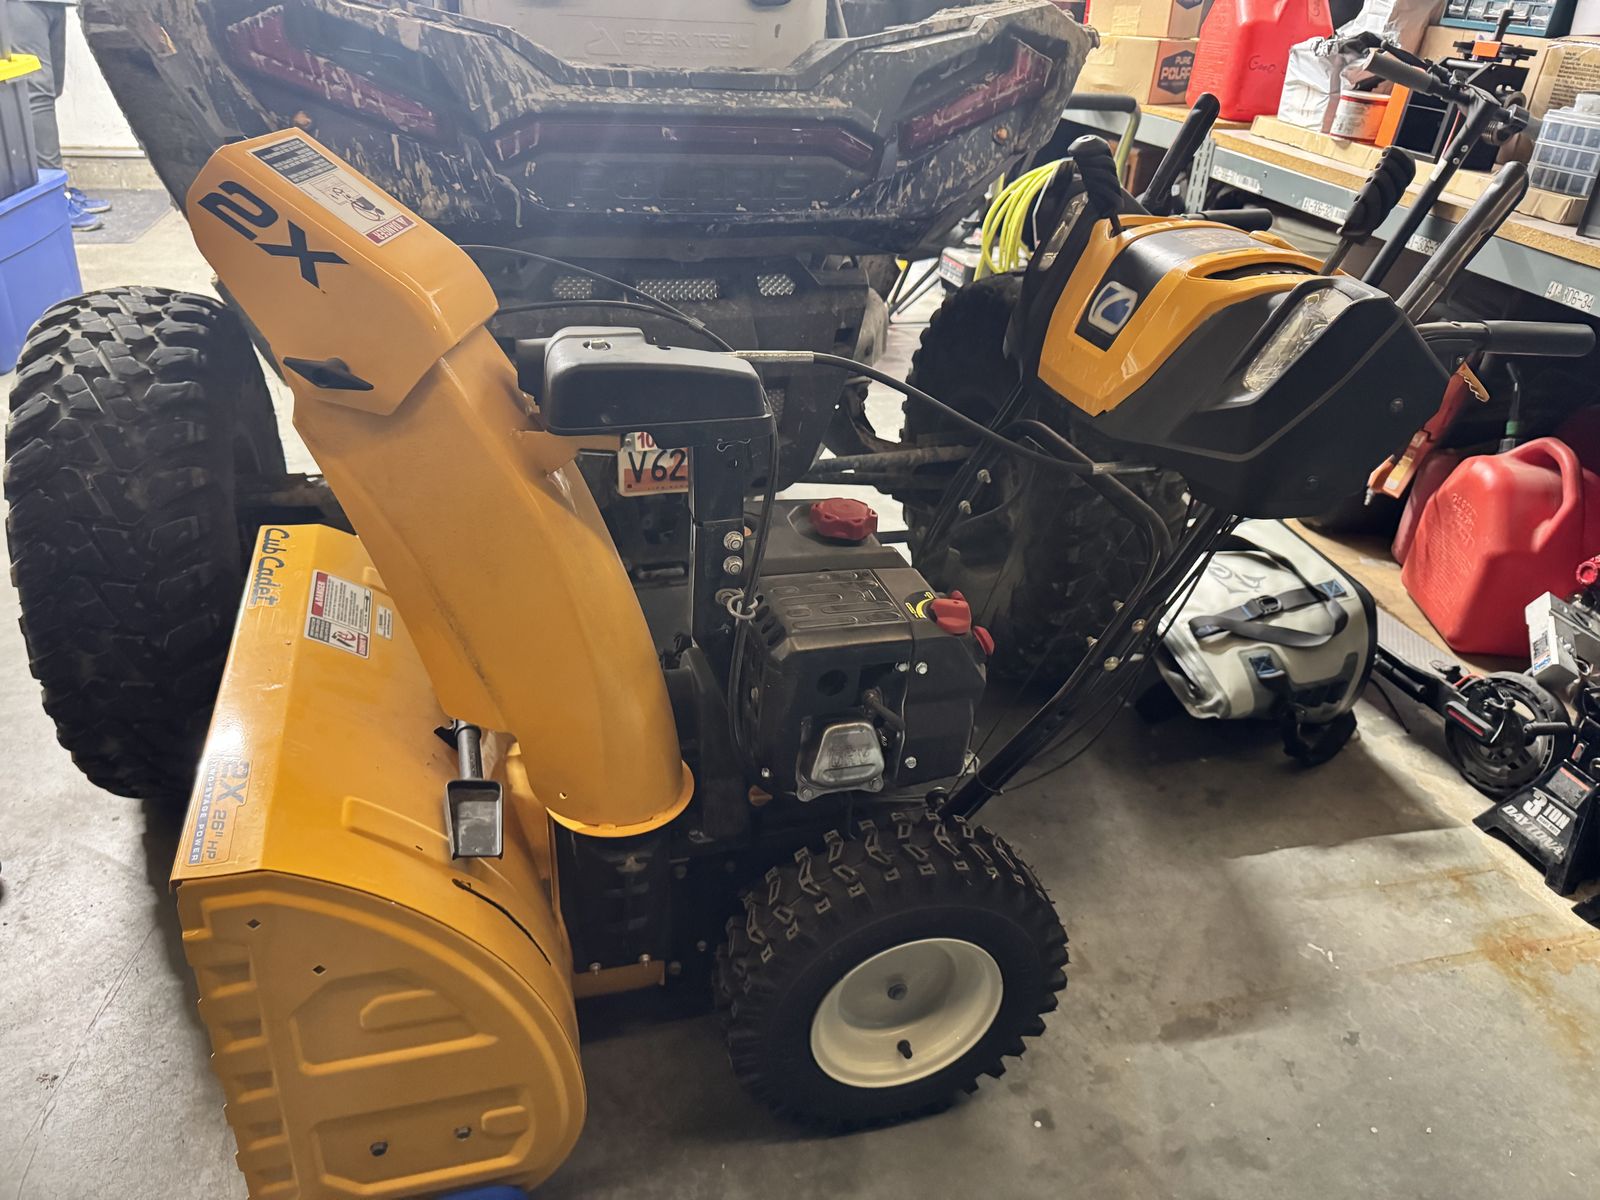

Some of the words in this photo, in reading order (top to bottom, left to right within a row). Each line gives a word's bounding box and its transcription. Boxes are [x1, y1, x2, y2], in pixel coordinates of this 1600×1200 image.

[197, 180, 350, 289] 2X
[637, 432, 655, 449] 10
[627, 448, 686, 484] V62
[262, 528, 290, 554] Cub
[251, 556, 285, 606] Cadet
[1522, 789, 1548, 817] 3
[1542, 802, 1571, 830] TON
[191, 823, 205, 861] POWER
[206, 840, 219, 860] HP
[1502, 804, 1565, 859] DAYTONA
